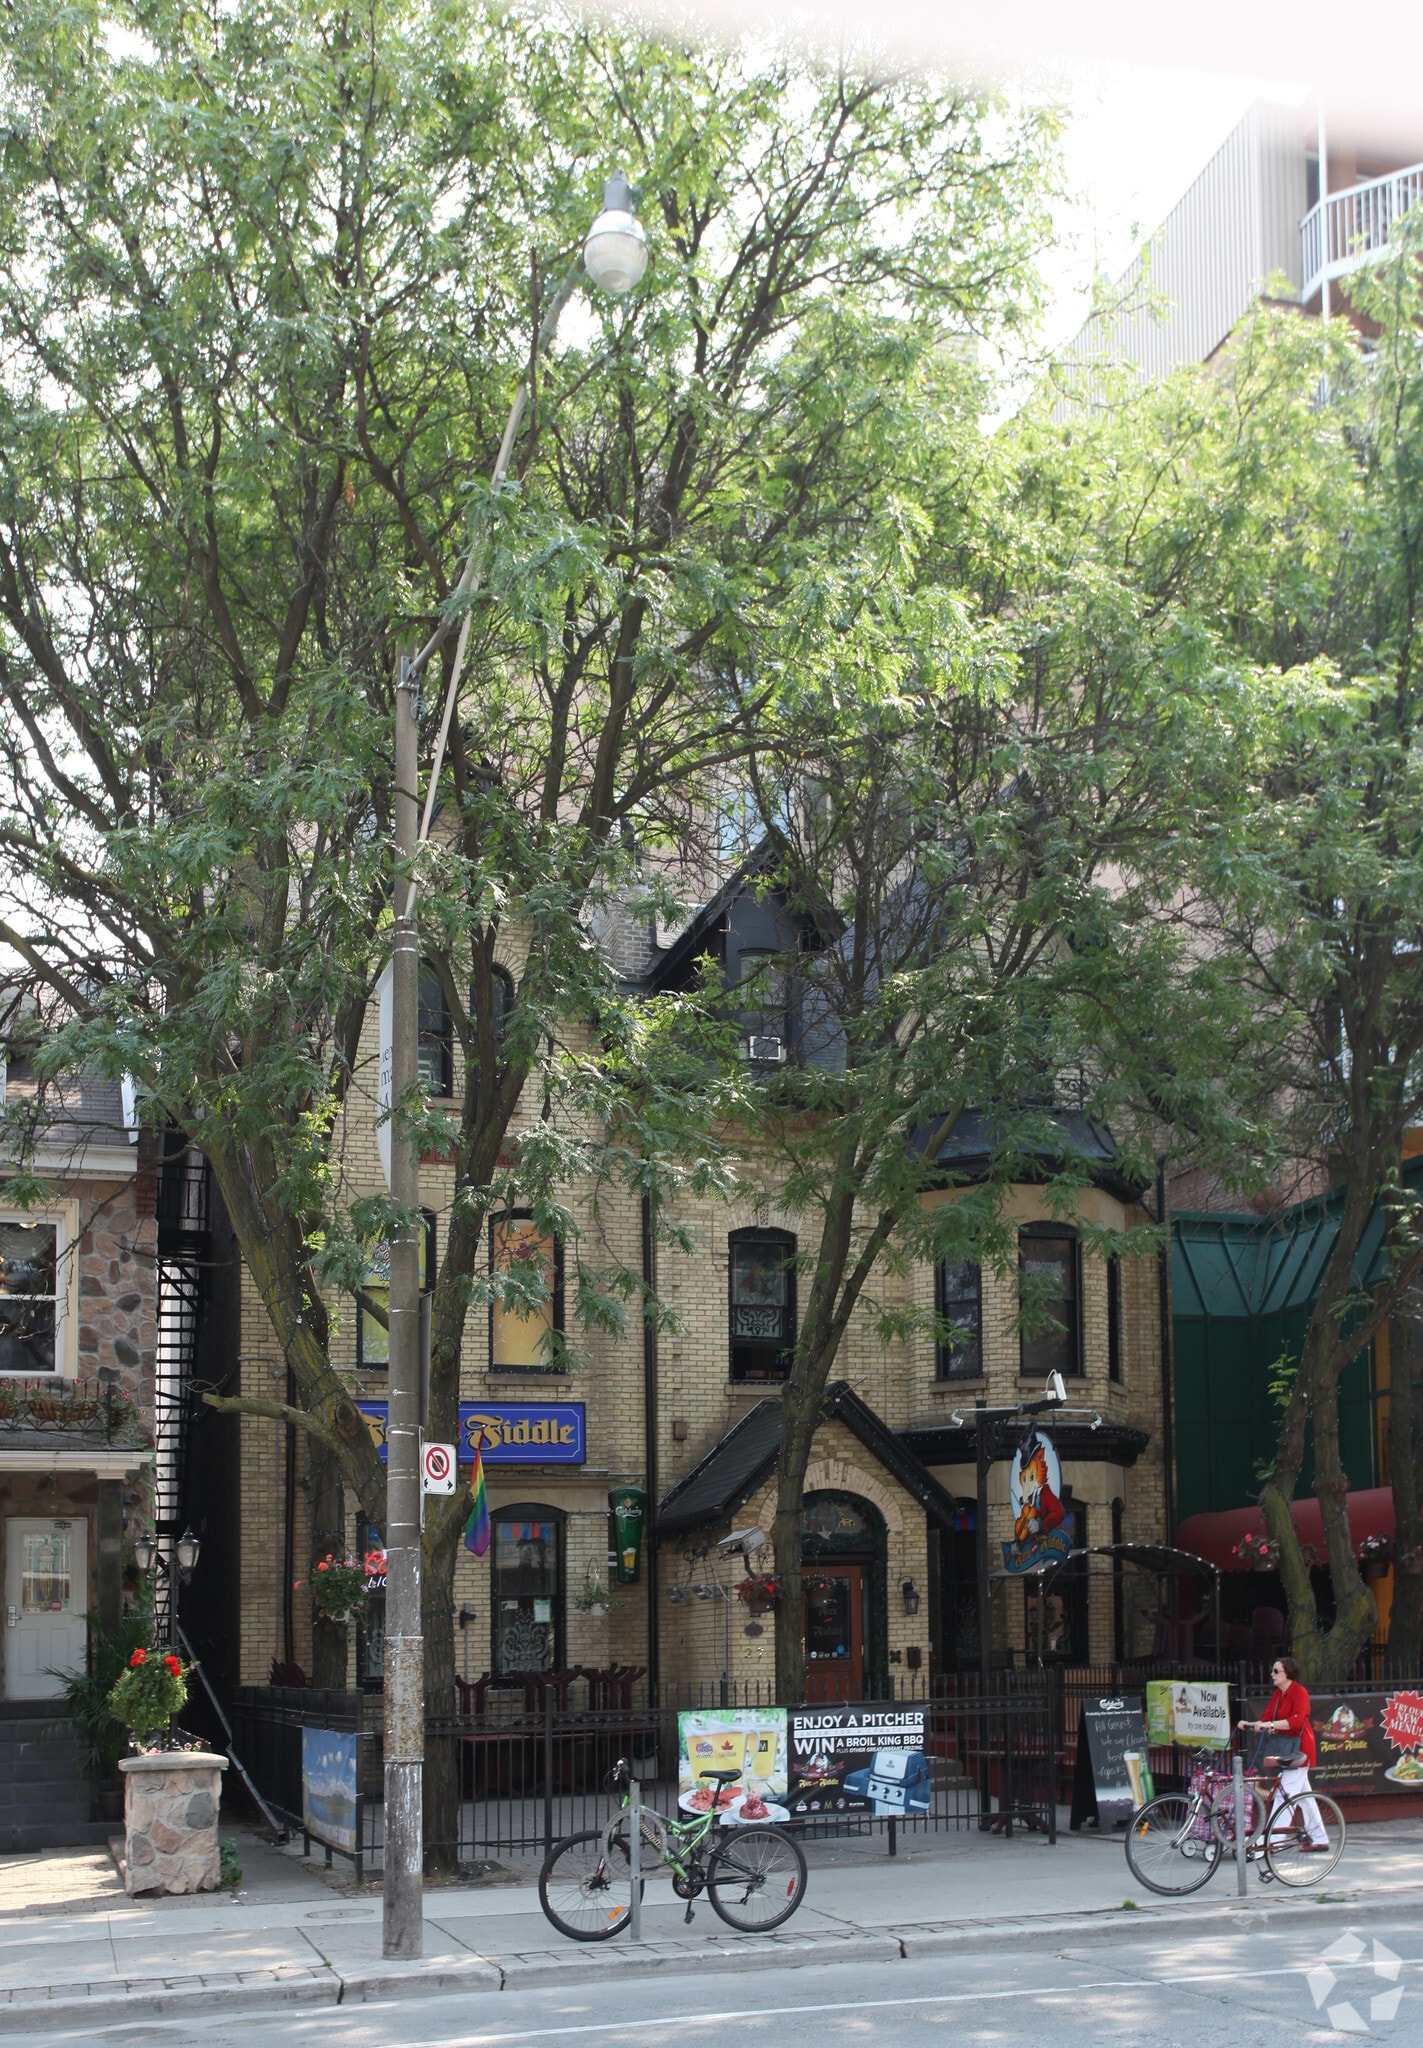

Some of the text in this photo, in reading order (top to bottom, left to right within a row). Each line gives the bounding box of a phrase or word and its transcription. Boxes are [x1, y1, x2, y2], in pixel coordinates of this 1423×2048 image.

[465, 1414, 575, 1450] Fiddle
[615, 1506, 642, 1518] Carlsberg
[744, 1647, 765, 1660] 27
[1201, 1690, 1218, 1702] Now
[1193, 1705, 1226, 1718] Available
[1394, 1702, 1408, 1712] TRY
[794, 1712, 924, 1729] ENJOY A PITCHER
[1397, 1711, 1420, 1724] NEW
[1203, 1722, 1217, 1732] today
[1390, 1719, 1422, 1736] MENU!
[794, 1735, 924, 1755] WIN A BROIL KING BBQ
